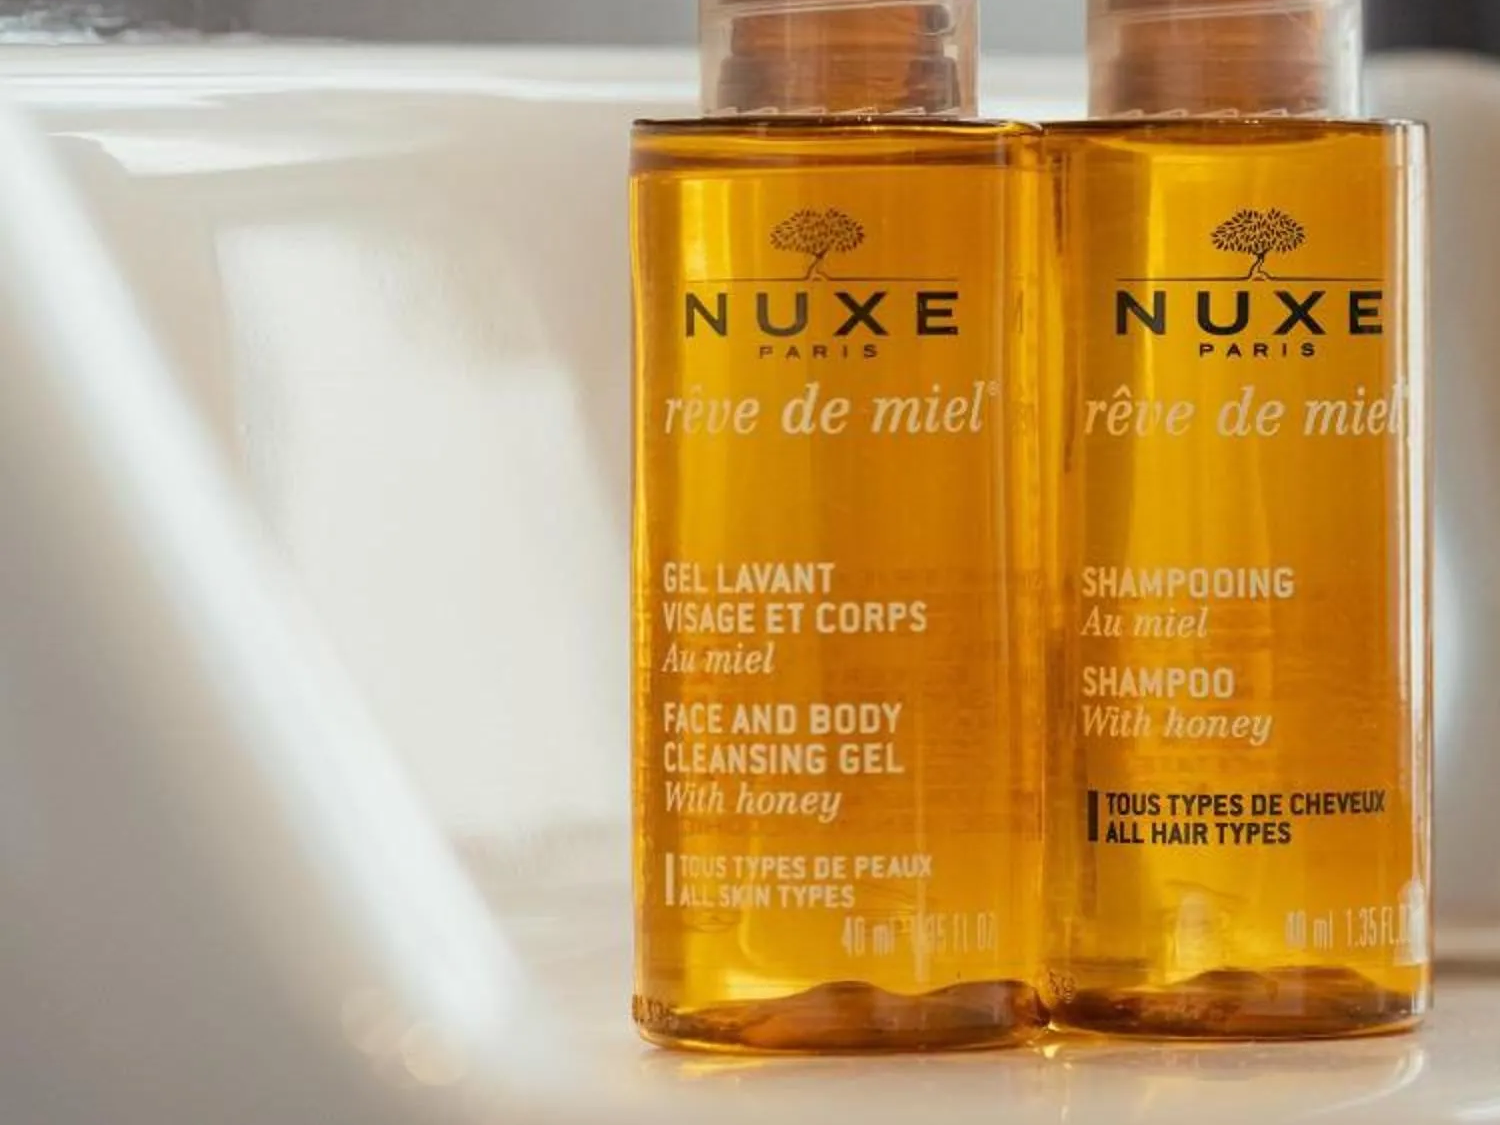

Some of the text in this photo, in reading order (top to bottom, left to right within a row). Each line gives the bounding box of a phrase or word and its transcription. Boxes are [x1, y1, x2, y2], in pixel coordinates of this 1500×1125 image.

[685, 291, 960, 338] NUXE
[1114, 290, 1384, 337] NUXE
[758, 343, 879, 361] PARIS
[1198, 342, 1316, 358] PARIS
[664, 384, 760, 436] rêve
[780, 380, 851, 435] de
[1084, 383, 1195, 436] rêve
[1216, 384, 1286, 437] de
[663, 562, 836, 595] GEL LAVANT
[1081, 566, 1296, 599] SHAMPOOING
[663, 601, 928, 634] VISAGE ET CORPS
[1080, 606, 1209, 639] Au miel
[661, 643, 776, 676] Au miel
[1081, 666, 1236, 700] SHAMPOO
[663, 702, 903, 735] FACE AND BODY
[1081, 706, 1274, 747] With honey
[663, 741, 905, 774] CLEANSING GEL
[664, 781, 843, 824] With honey
[1105, 789, 1386, 818] TOUS TYPES DE CHEVEUX
[1105, 821, 1292, 846] ALL HAIR TYPES
[679, 854, 933, 881] TOUS TYPES DE PEAUX
[679, 884, 856, 909] ALL SKIN TYPES
[841, 915, 866, 958] 40
[1312, 908, 1334, 952] ml
[1346, 904, 1378, 950] 1.35
